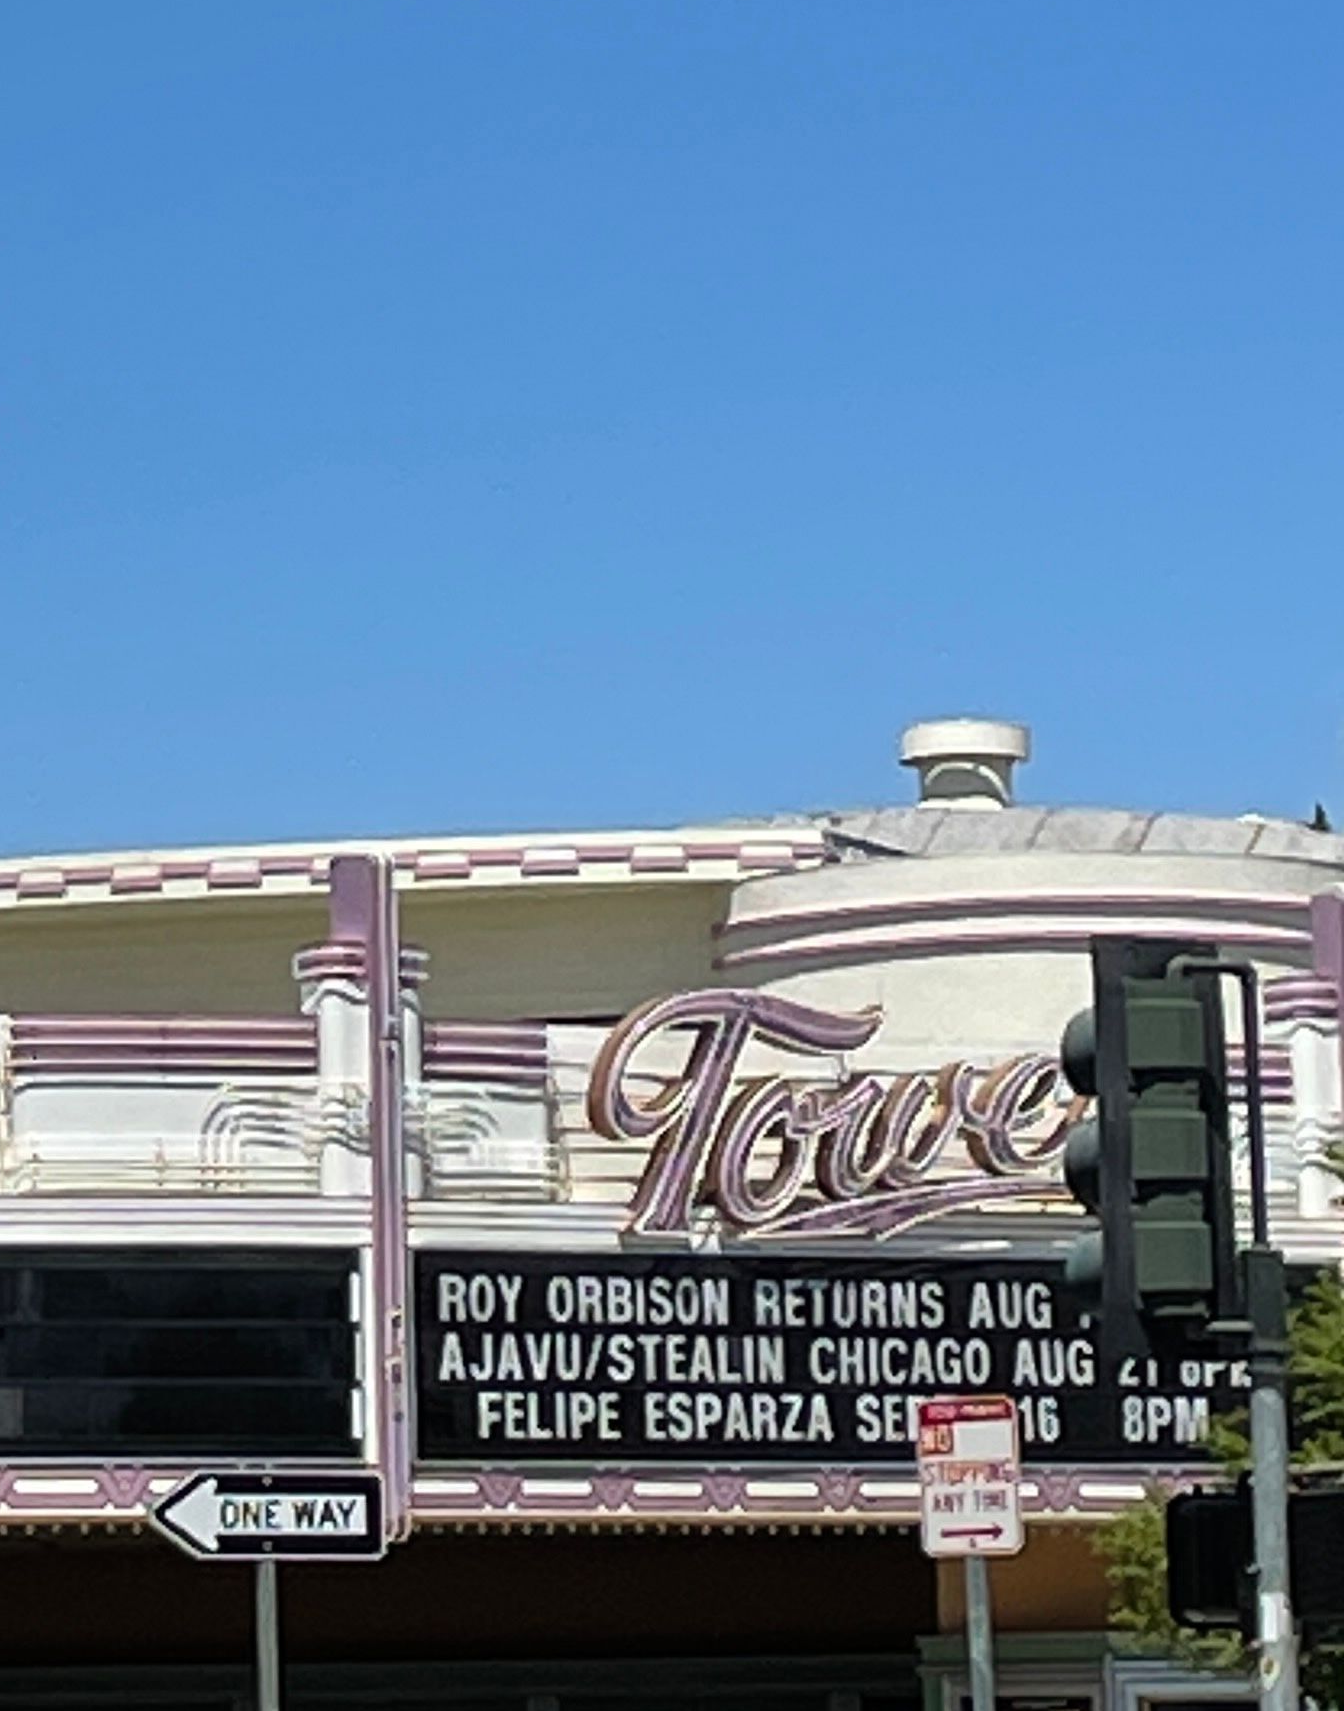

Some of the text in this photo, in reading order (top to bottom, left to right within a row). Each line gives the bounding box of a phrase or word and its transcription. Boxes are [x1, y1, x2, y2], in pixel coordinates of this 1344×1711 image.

[586, 987, 1094, 1241] Towe
[438, 1273, 1053, 1330] ROY ORBISON RETURNS AUG
[438, 1332, 785, 1384] AJAVU/STEALIN
[809, 1337, 992, 1386] CHICAGO
[1012, 1339, 1096, 1387] AUG
[477, 1391, 623, 1440] FELIPE
[644, 1392, 836, 1442] ESPARZA
[1121, 1395, 1211, 1444] 8PM
[220, 1499, 358, 1530] ONE WAY
